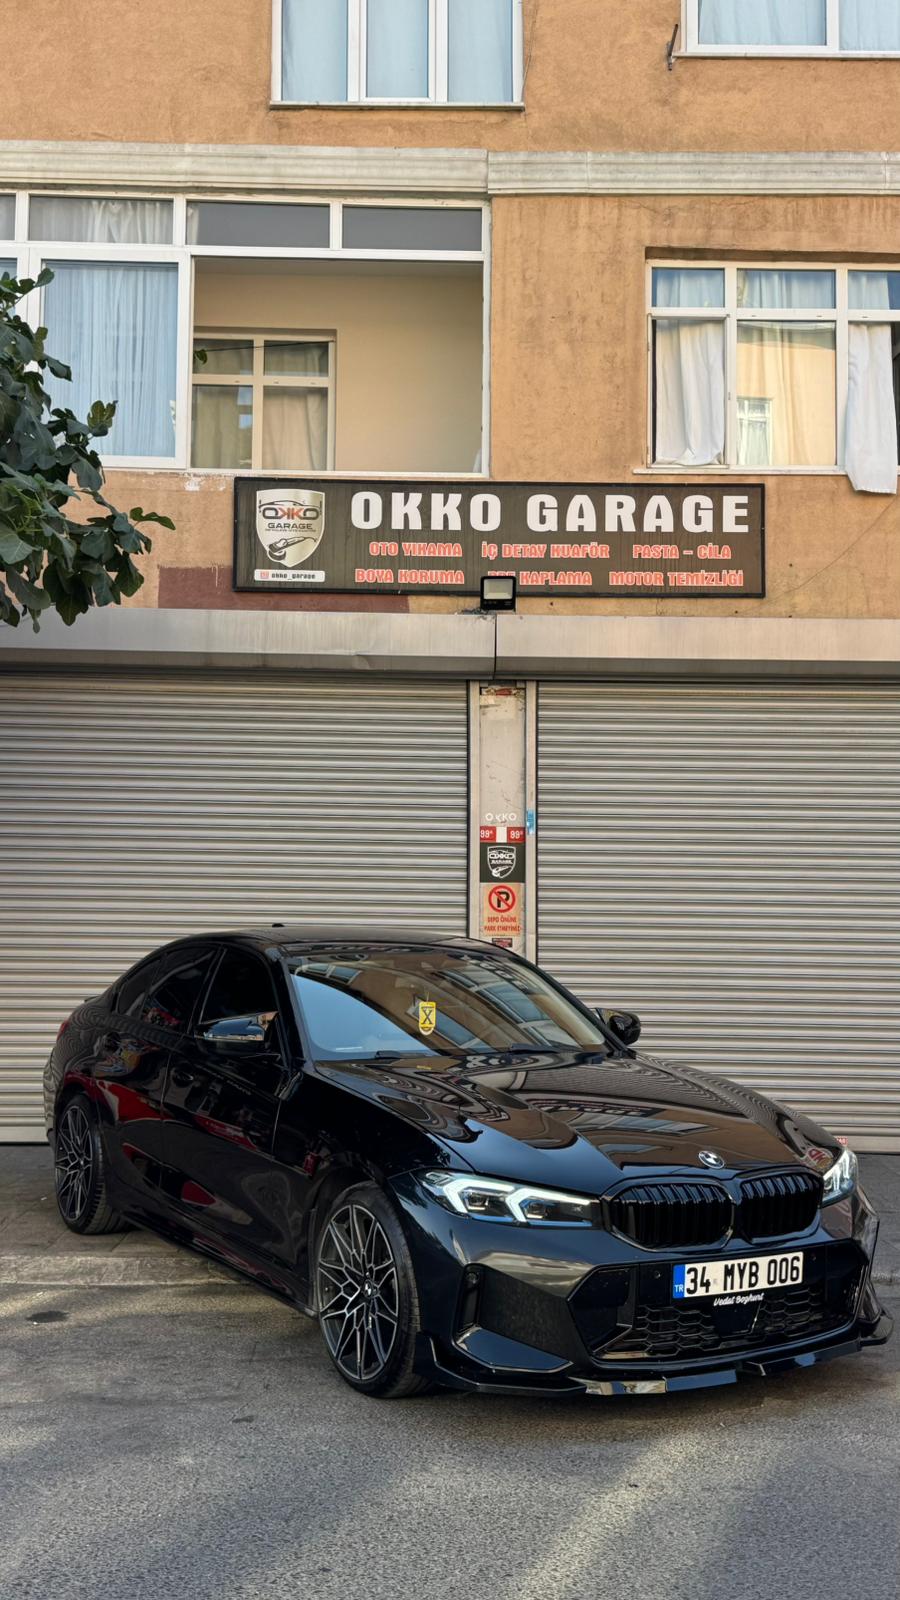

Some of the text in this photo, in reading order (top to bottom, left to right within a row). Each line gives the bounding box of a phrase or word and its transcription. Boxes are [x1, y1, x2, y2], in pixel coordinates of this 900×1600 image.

[351, 491, 749, 533] OKKO GARAGE
[267, 522, 313, 530] GARAGE
[369, 541, 463, 558] OTO YIKAMA
[481, 541, 610, 561] İÇ DETAY KUAFÖR
[632, 544, 680, 560] PASTA
[697, 543, 732, 560] CİLA
[355, 568, 465, 585] BOYA KORUMA
[519, 571, 593, 586] KAPLAMA
[609, 569, 744, 587] MOTOR TEMİZLİĞİ
[674, 1256, 800, 1295] TR 34 MYB 006
